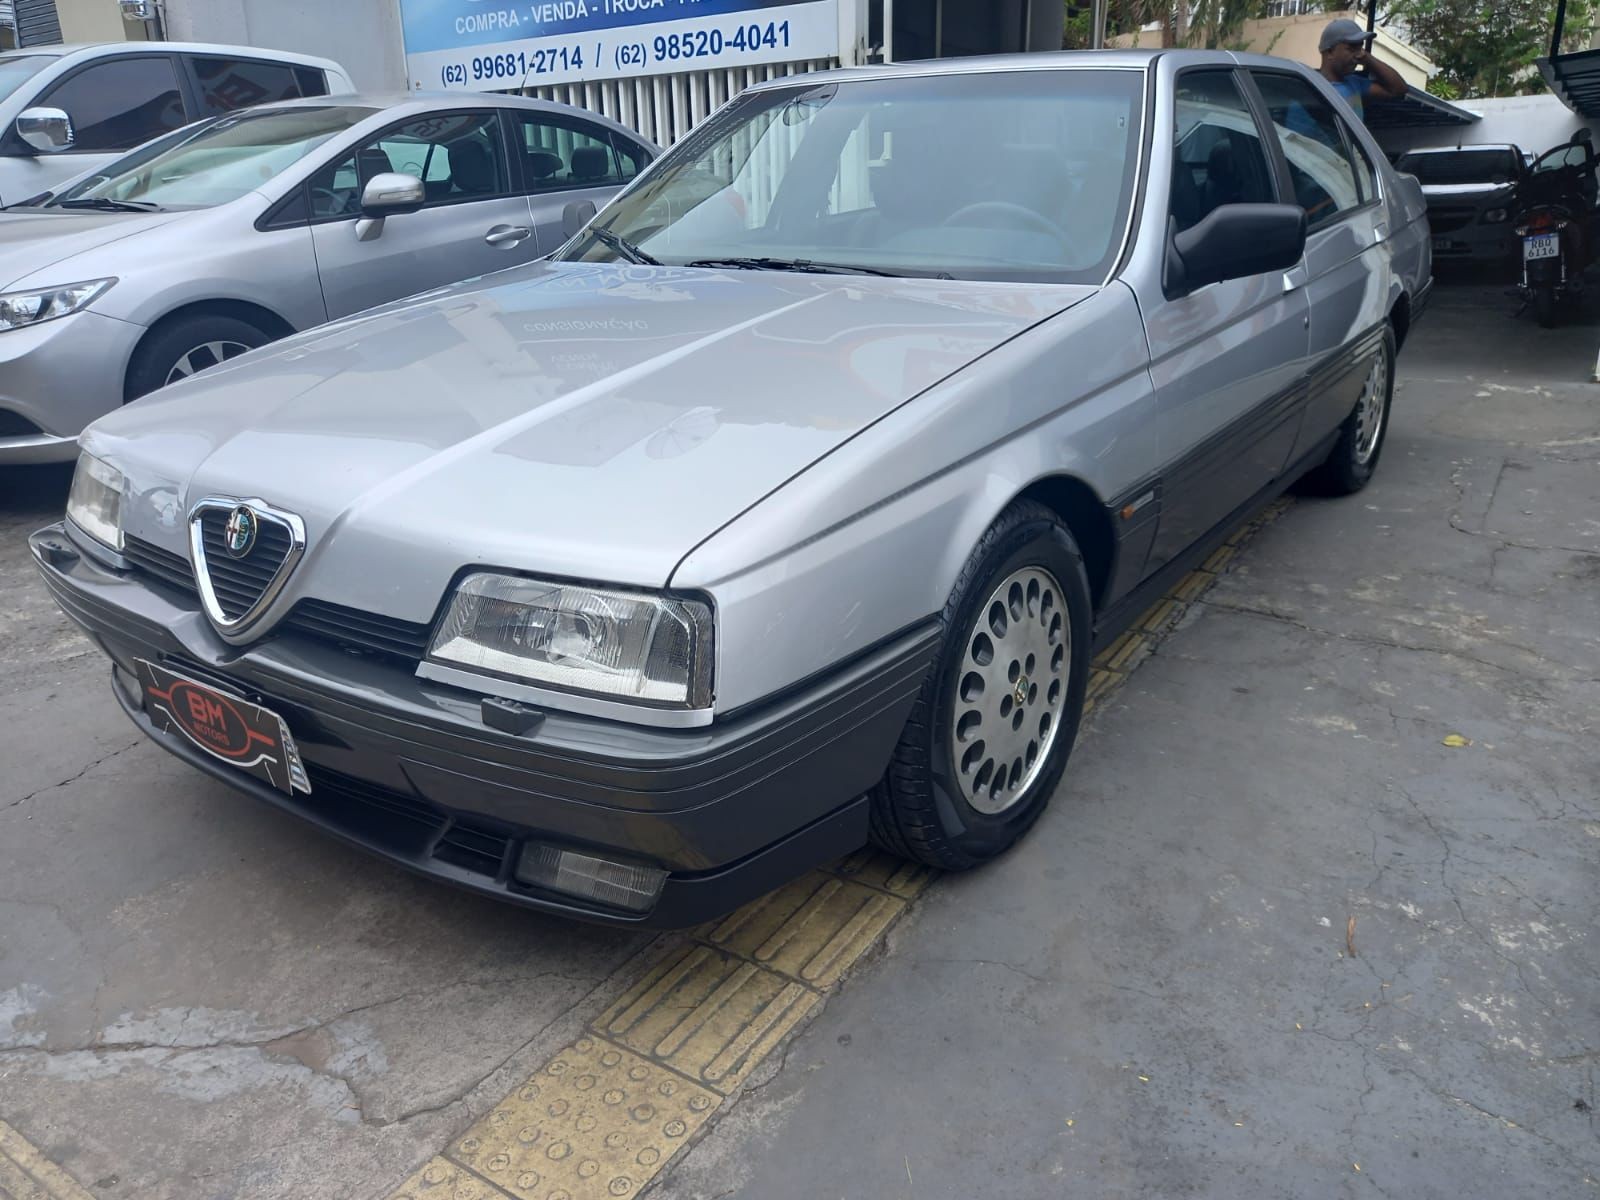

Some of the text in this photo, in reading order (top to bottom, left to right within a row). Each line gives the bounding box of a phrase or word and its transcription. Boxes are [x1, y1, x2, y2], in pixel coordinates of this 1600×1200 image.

[455, 9, 520, 34] COMPRA
[531, 0, 588, 24] VENDA
[441, 63, 467, 88] (62)
[472, 45, 583, 80] 99681-2714
[615, 43, 647, 70] (62)
[653, 20, 789, 61] 98520-4041
[186, 690, 227, 731] BM
